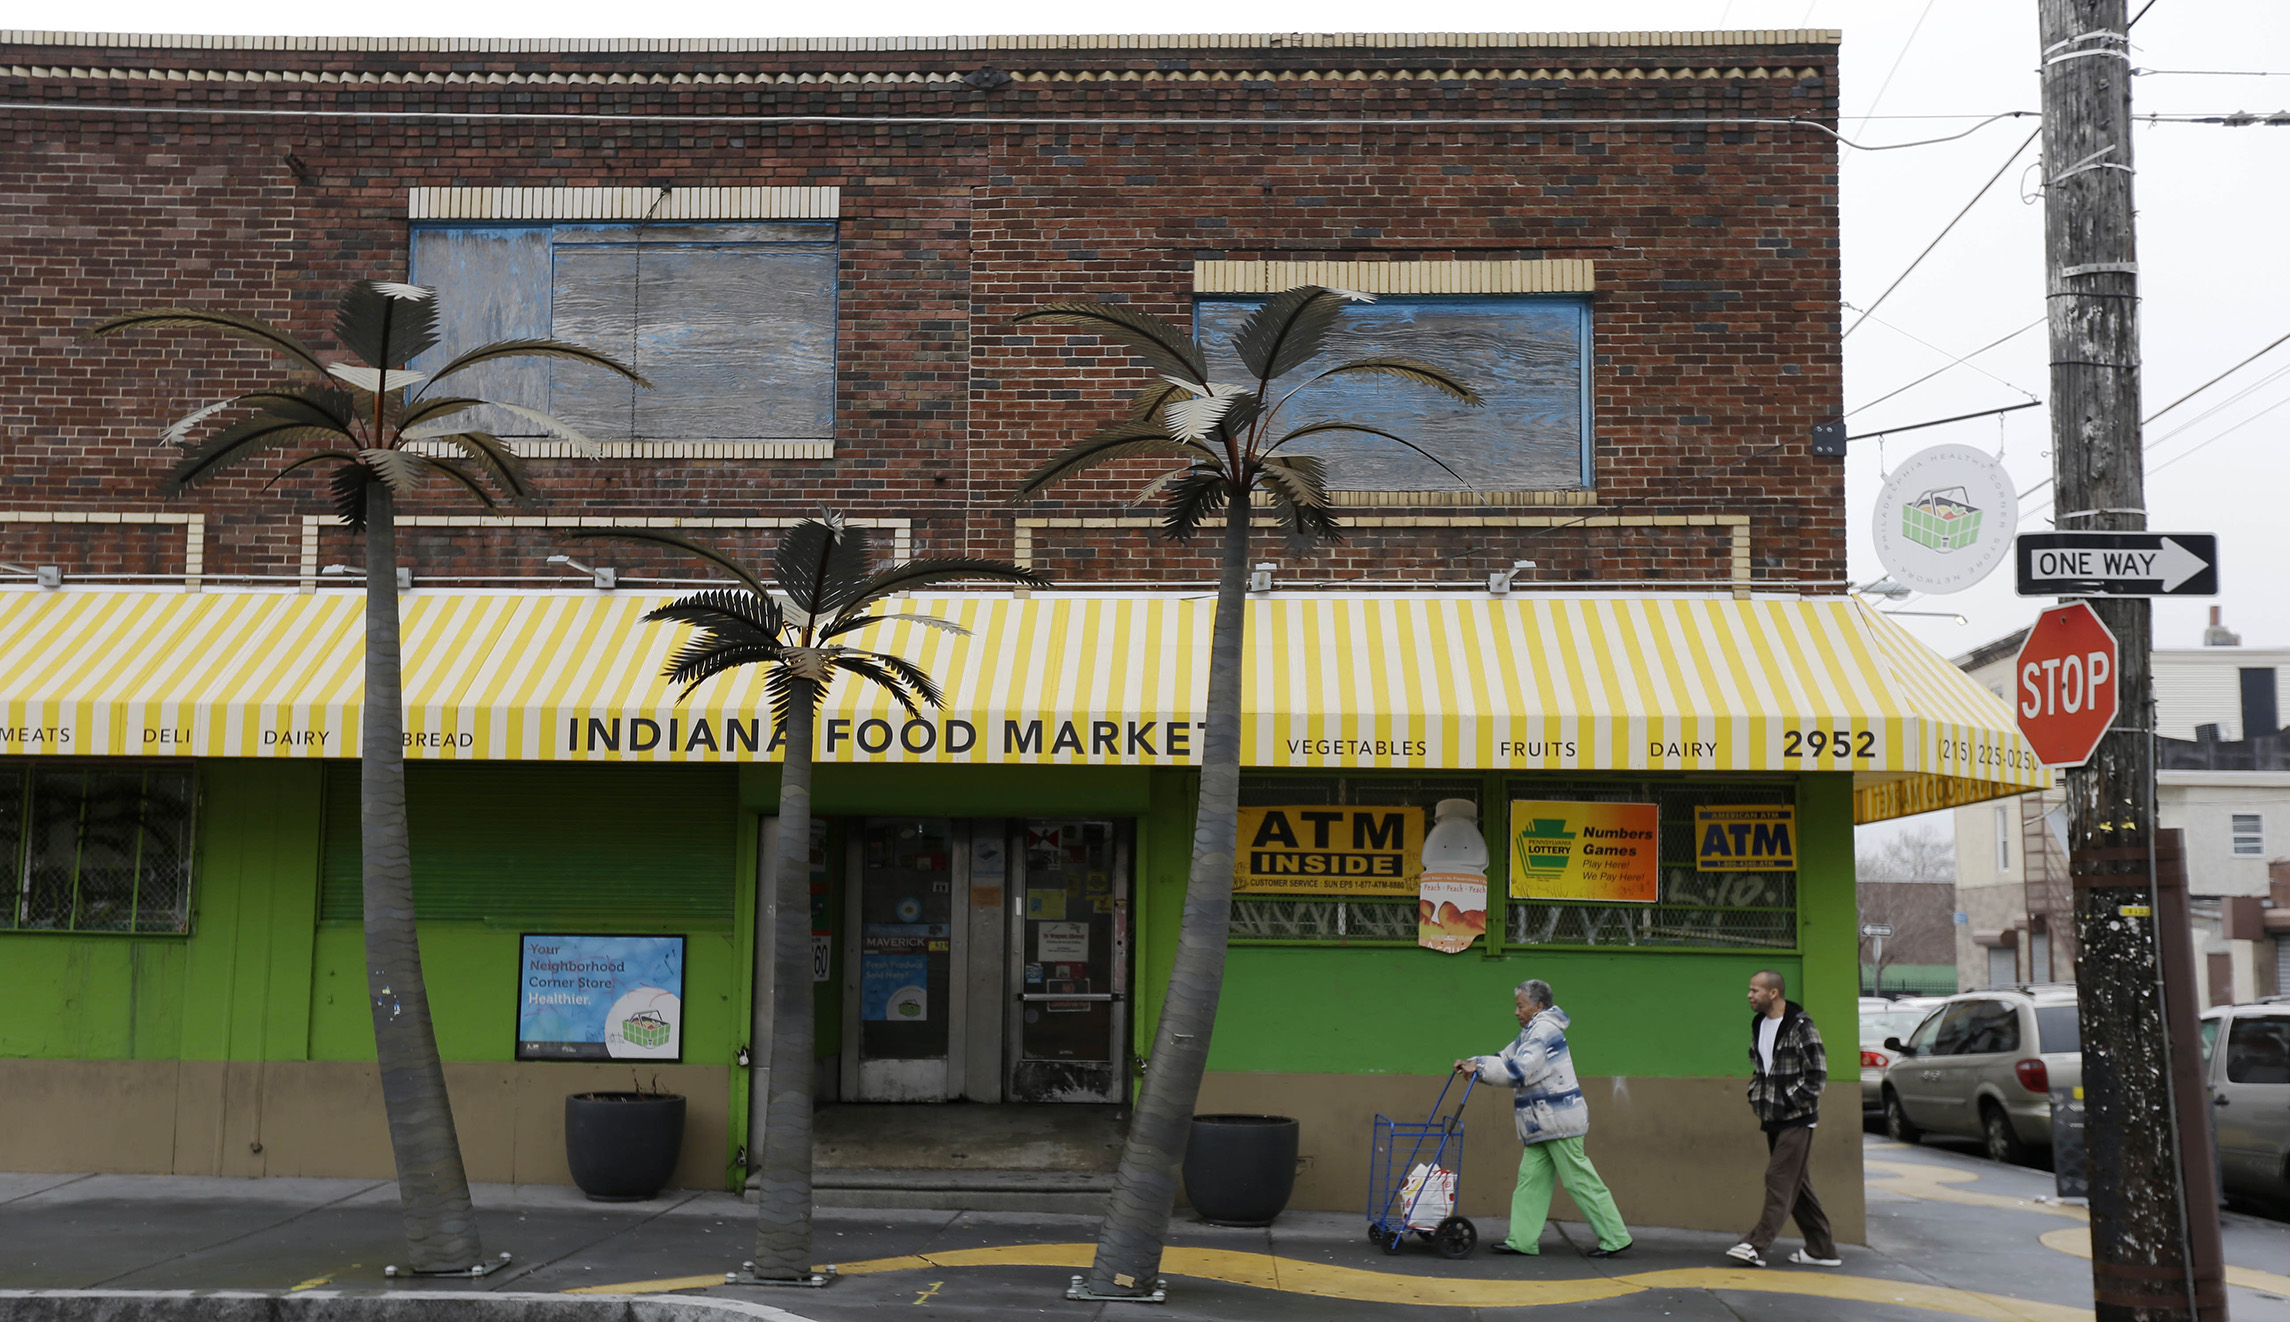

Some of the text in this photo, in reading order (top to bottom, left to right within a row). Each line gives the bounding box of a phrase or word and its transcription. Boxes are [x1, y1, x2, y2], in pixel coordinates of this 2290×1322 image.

[2039, 552, 2156, 576] ONE WAY
[2021, 650, 2111, 719] STOP
[0, 727, 71, 743] MEATS
[143, 728, 191, 744] DELI
[263, 730, 330, 746] DAIRY
[402, 732, 473, 748] BREAD
[826, 717, 977, 754] FOOD
[1003, 719, 1206, 756] MARKE
[1286, 739, 1428, 757] VEGETABLES
[1500, 741, 1577, 758] FRUITS
[1650, 741, 1718, 758] DAIRY
[1783, 730, 1876, 758] 2952
[1938, 738, 1973, 765] (215)
[1760, 811, 1779, 819] ATM
[1251, 810, 1405, 850] ATM
[1582, 826, 1653, 840] Numbers
[1700, 823, 1792, 856] ATM
[1528, 846, 1572, 855] LOTTERY
[1582, 844, 1637, 857] Games
[1261, 854, 1395, 875] INSIDE
[1582, 859, 1630, 872] Play Here!
[1250, 878, 1288, 888] CUSTOMER
[1290, 879, 1318, 888] SERVICE
[1324, 880, 1338, 888] SUN
[1582, 872, 1645, 884] We Pay Here!
[530, 943, 561, 955] Your
[866, 937, 926, 947] MAVERICK
[529, 960, 625, 974] Neighborhood
[528, 976, 612, 989] Corner Store
[528, 992, 592, 1006] Healthier.
